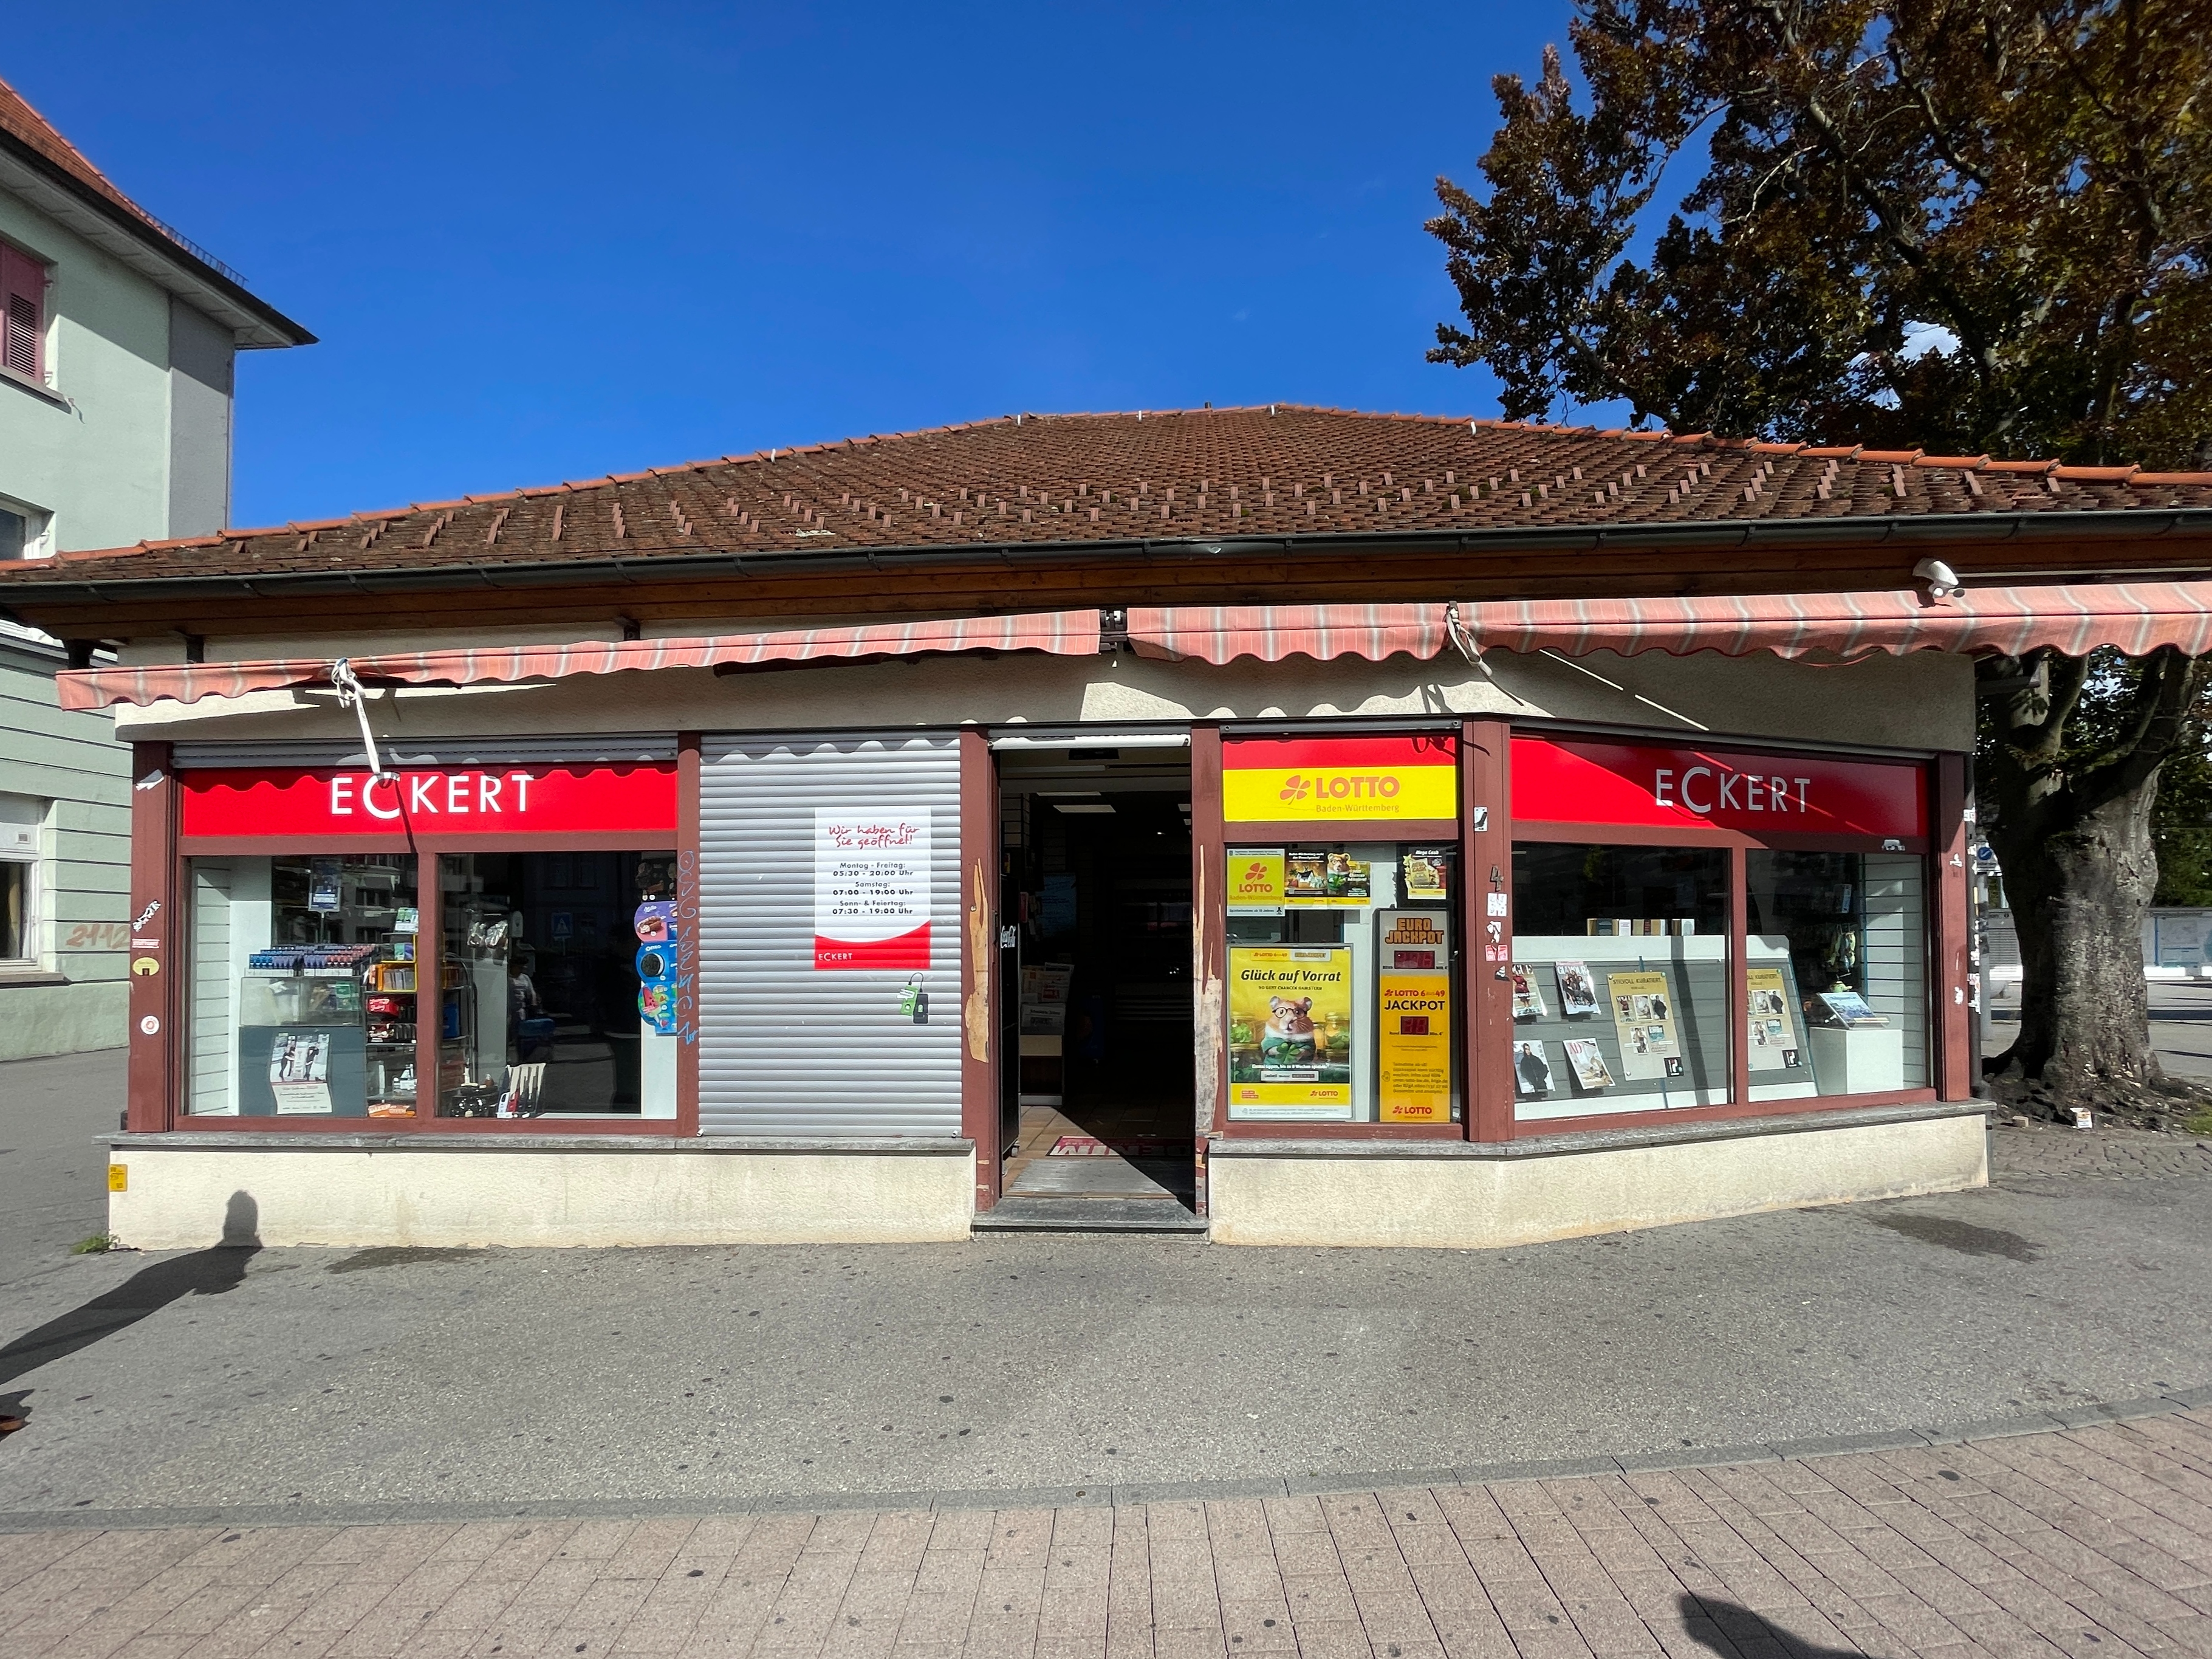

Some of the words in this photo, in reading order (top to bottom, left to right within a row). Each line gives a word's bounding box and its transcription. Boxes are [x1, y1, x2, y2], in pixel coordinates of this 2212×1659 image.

[1316, 776, 1400, 799] LOTTO
[1656, 766, 1810, 813] ECKERT
[331, 772, 535, 819] ECKERT
[1316, 804, 1400, 813] Baden-Württemberg
[829, 824, 852, 835] Wir
[857, 824, 895, 835] haben
[899, 822, 920, 836] für
[836, 834, 853, 848] Sie
[857, 834, 913, 850] geöffnet!
[1490, 865, 1504, 892] 4
[1239, 884, 1273, 893] LOTTO
[1397, 918, 1432, 930] EURO
[1385, 930, 1444, 944] JACKPOT
[818, 952, 853, 961] ECKERT
[1241, 969, 1276, 981] Glück
[1278, 970, 1300, 984] auf
[1303, 970, 1341, 981] Vorrat
[1384, 1000, 1445, 1010] JACKPOT
